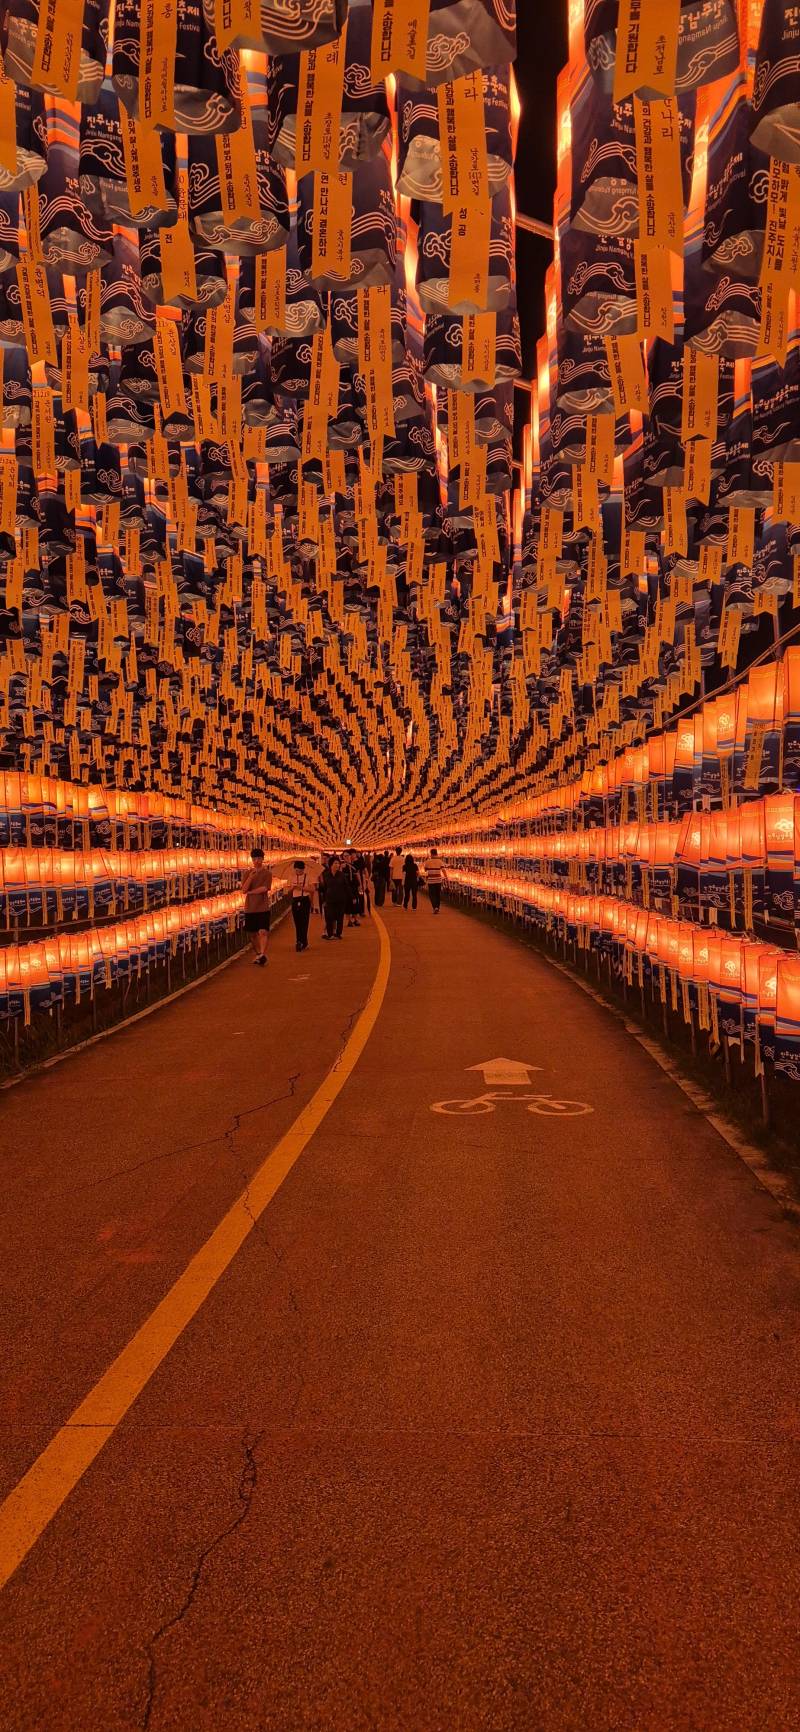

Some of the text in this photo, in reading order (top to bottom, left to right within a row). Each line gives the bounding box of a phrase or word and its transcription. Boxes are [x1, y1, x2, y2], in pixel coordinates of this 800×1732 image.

[381, 12, 394, 62] 소망합니다
[624, 24, 640, 74] 기원합니다
[304, 101, 313, 117] 삶을
[302, 120, 312, 162] 소망합니다
[447, 136, 457, 151] 삶을
[448, 154, 460, 196] 소망합니다
[645, 175, 654, 191] 삶을
[319, 187, 329, 216] 만나서
[645, 193, 656, 237] 소망합니다
[318, 219, 328, 257] 결혼하자
[643, 293, 652, 328] 소망합니다
